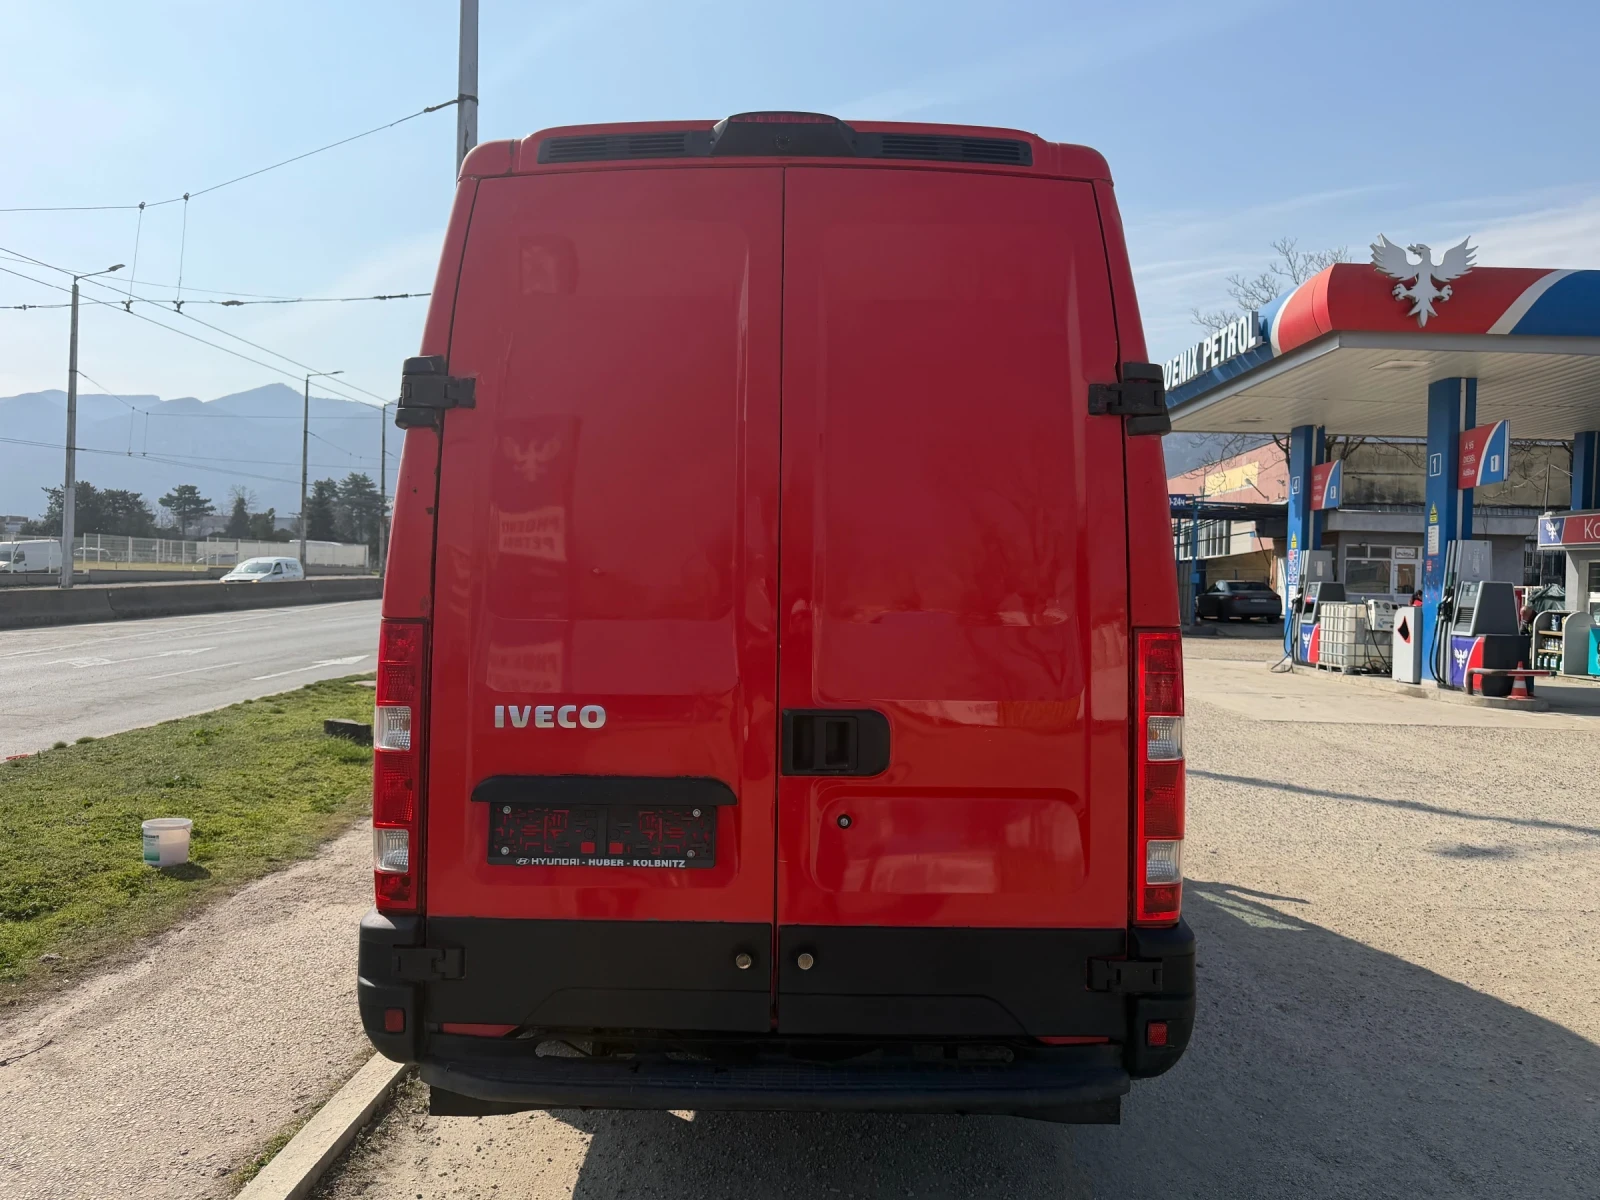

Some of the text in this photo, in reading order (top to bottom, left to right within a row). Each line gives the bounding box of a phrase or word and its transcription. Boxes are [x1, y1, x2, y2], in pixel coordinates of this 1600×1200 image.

[1162, 311, 1256, 391] OENIX PETROL
[494, 704, 606, 729] IVECO
[531, 857, 580, 866] HYUNDAI
[588, 858, 624, 867] HUBER
[633, 859, 686, 868] KOLBNITZ
